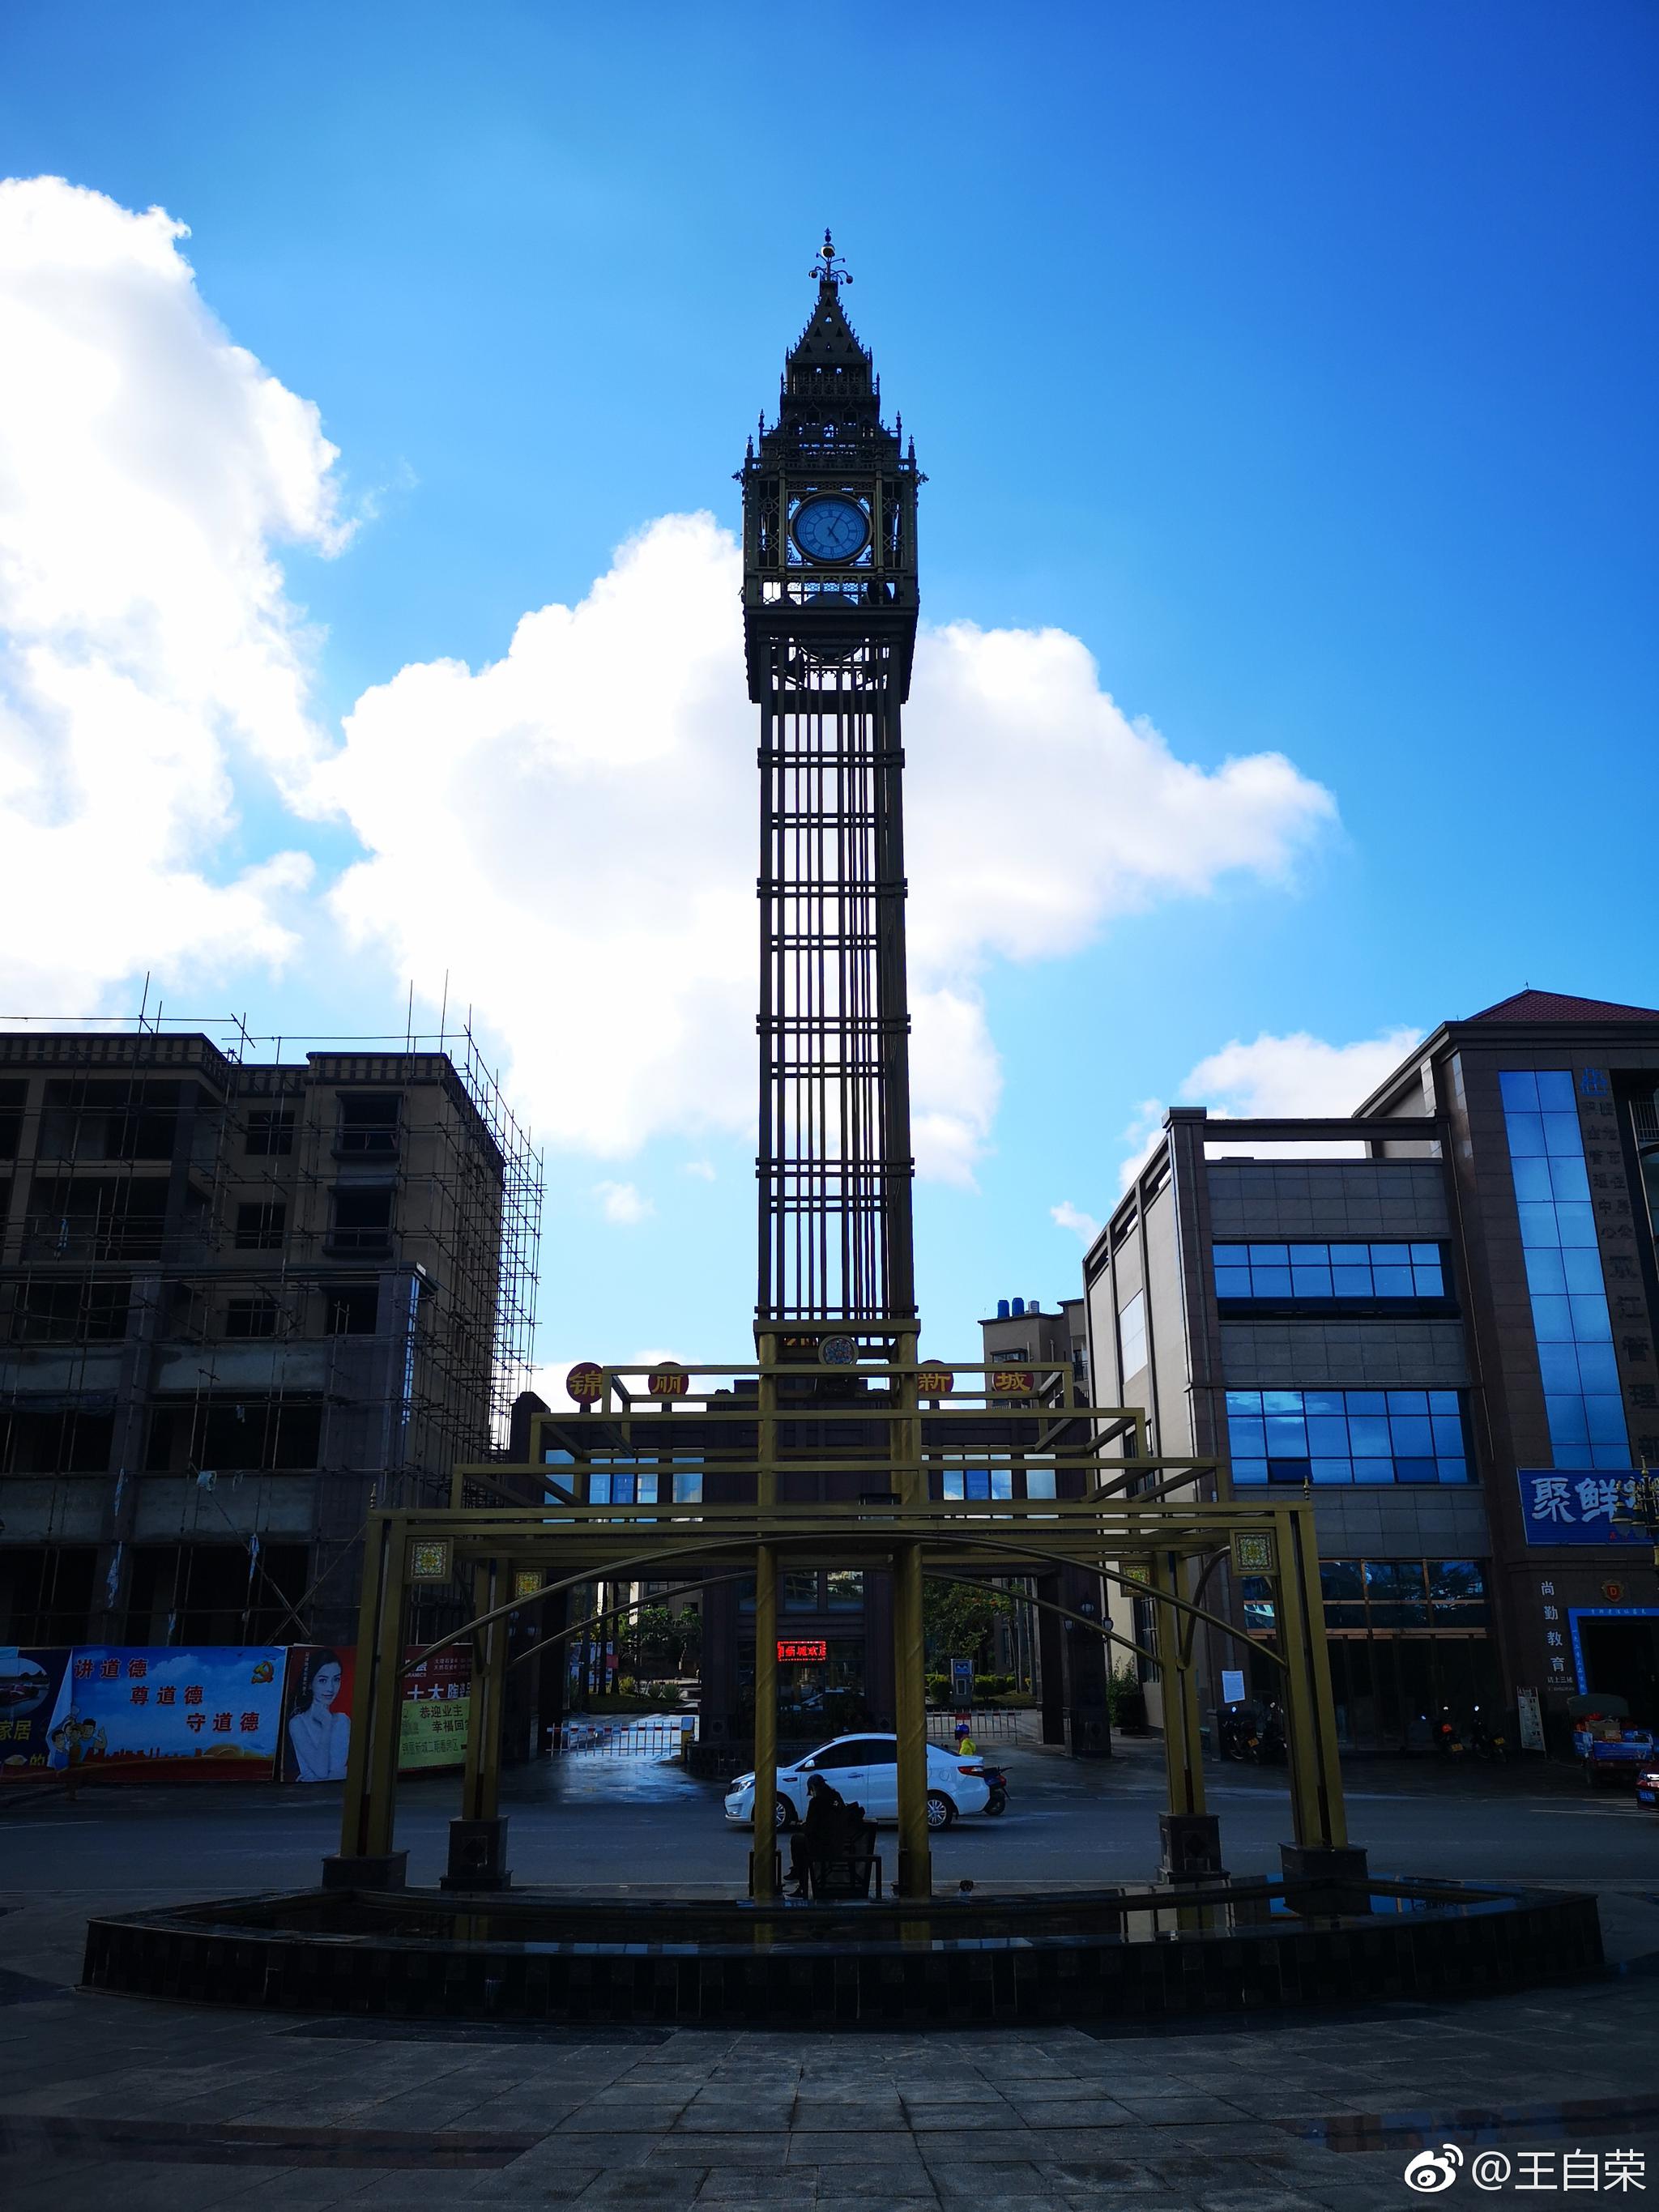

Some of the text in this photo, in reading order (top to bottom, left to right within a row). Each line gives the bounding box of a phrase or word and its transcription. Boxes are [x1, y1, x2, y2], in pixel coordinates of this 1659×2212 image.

[1530, 1477, 1657, 1524] 聚鲜
[1541, 1580, 1566, 1673] 尚勤教育
[75, 1659, 147, 1679] 讲道德
[130, 1686, 203, 1705] 尊道德
[420, 1704, 463, 1718] 恭迎业主
[187, 1712, 259, 1733] 守道德
